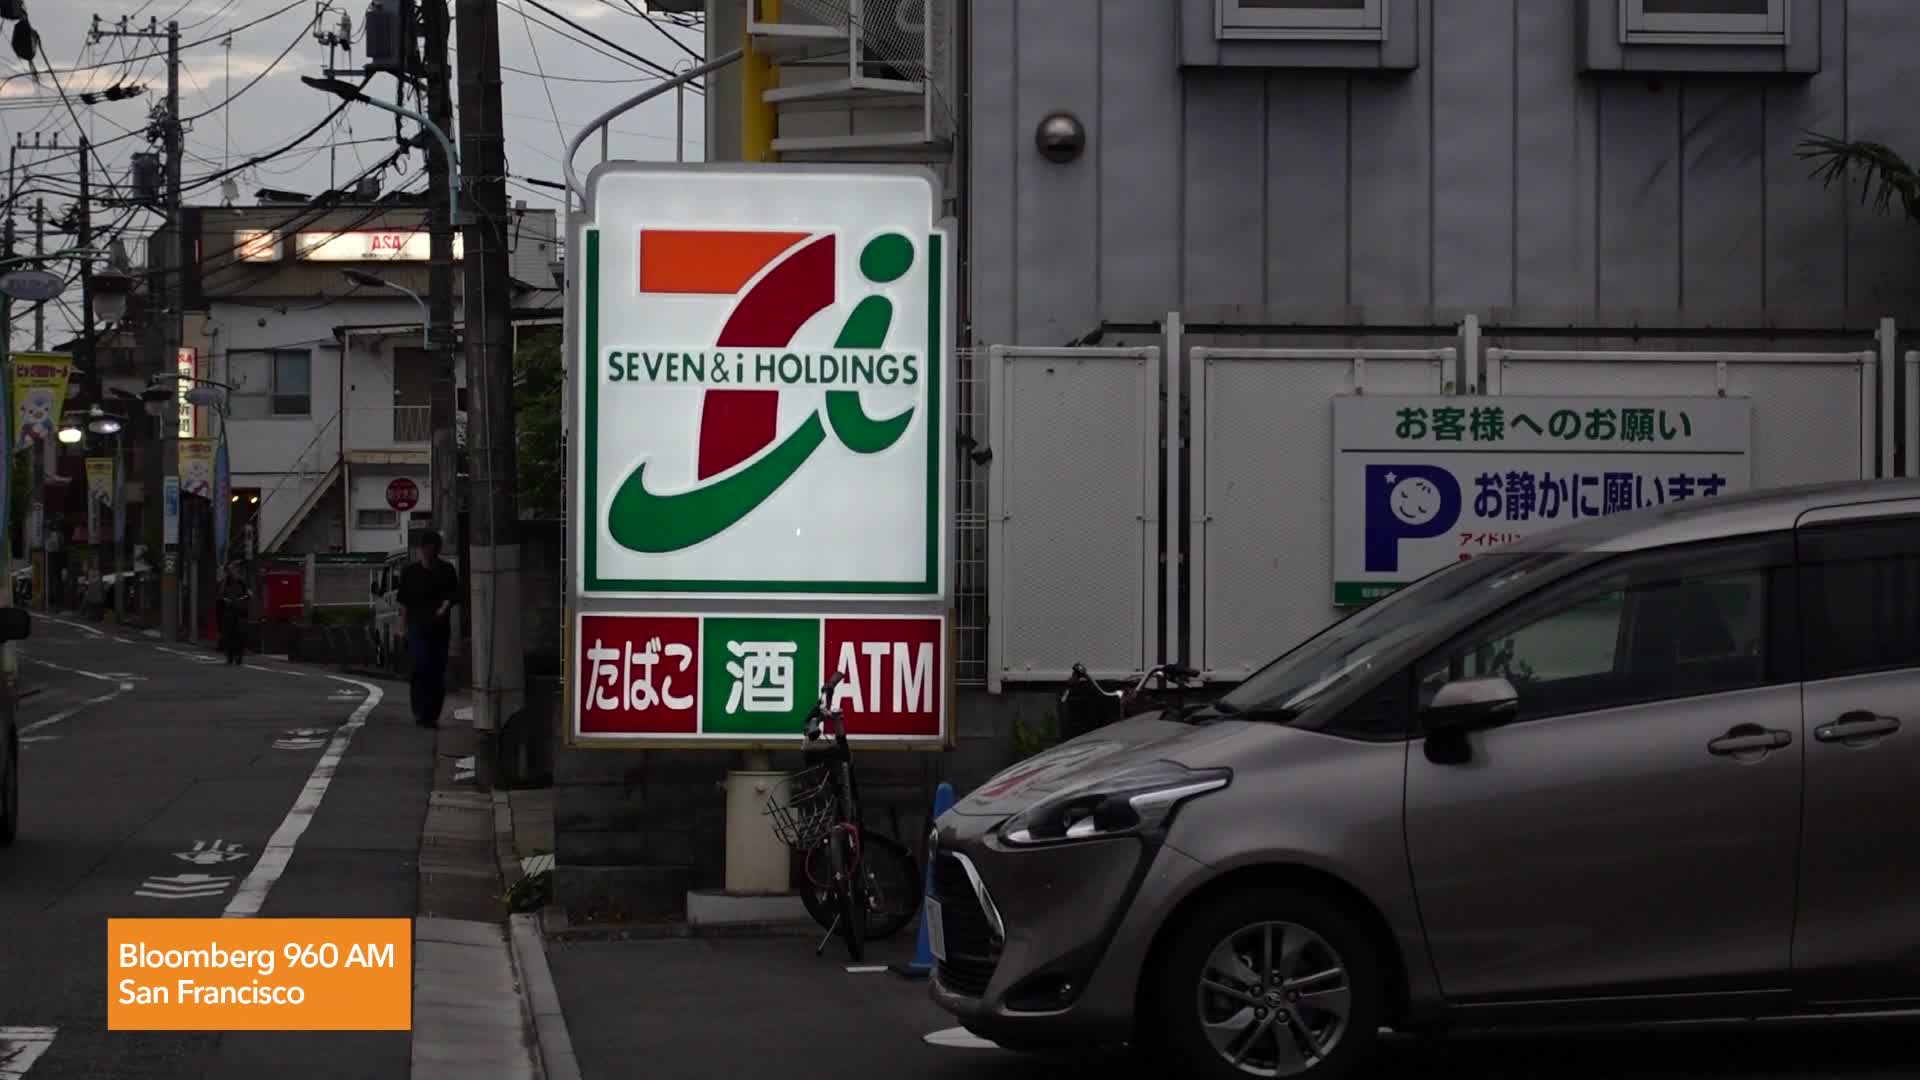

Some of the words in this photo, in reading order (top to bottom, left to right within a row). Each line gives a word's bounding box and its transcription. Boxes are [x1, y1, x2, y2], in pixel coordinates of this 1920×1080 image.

[372, 234, 401, 250] ASA
[755, 353, 919, 385] HOLDINGS
[1395, 407, 1692, 442] お客様へのお願い
[586, 637, 694, 711] たばこ
[725, 640, 798, 715] 酒
[831, 641, 934, 713] ATM
